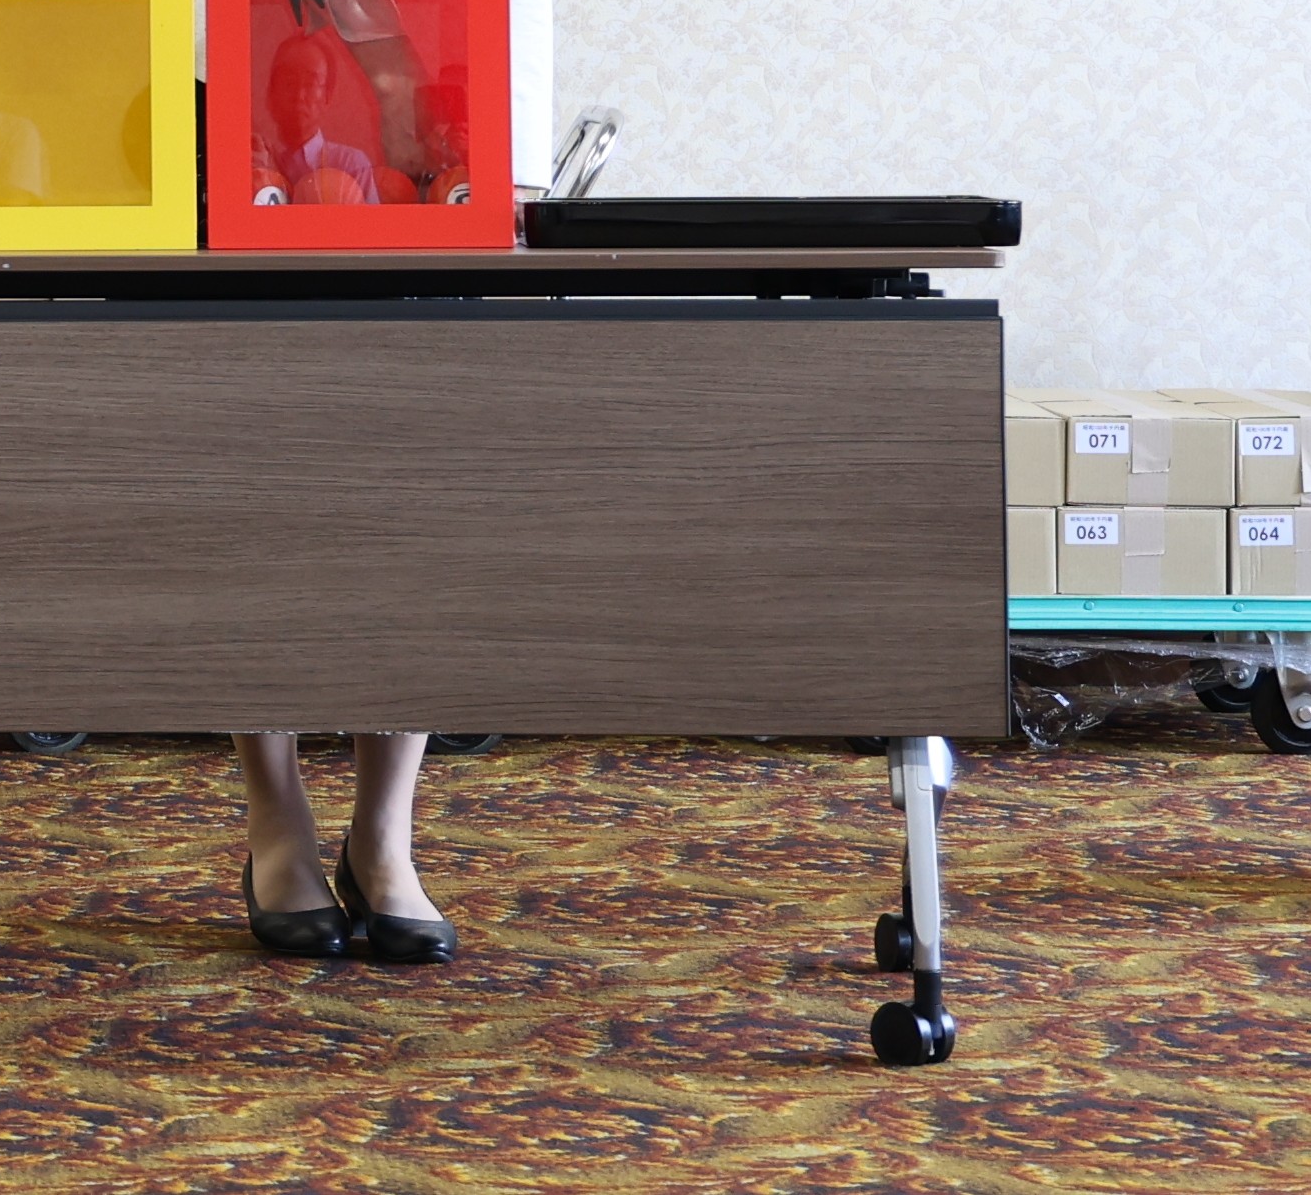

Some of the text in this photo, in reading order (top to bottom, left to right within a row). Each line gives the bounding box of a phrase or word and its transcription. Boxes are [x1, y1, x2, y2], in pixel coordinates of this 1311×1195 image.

[1089, 434, 1117, 448] 071
[1252, 436, 1283, 450] 072
[1076, 525, 1107, 540] 063
[1248, 526, 1279, 541] 064
